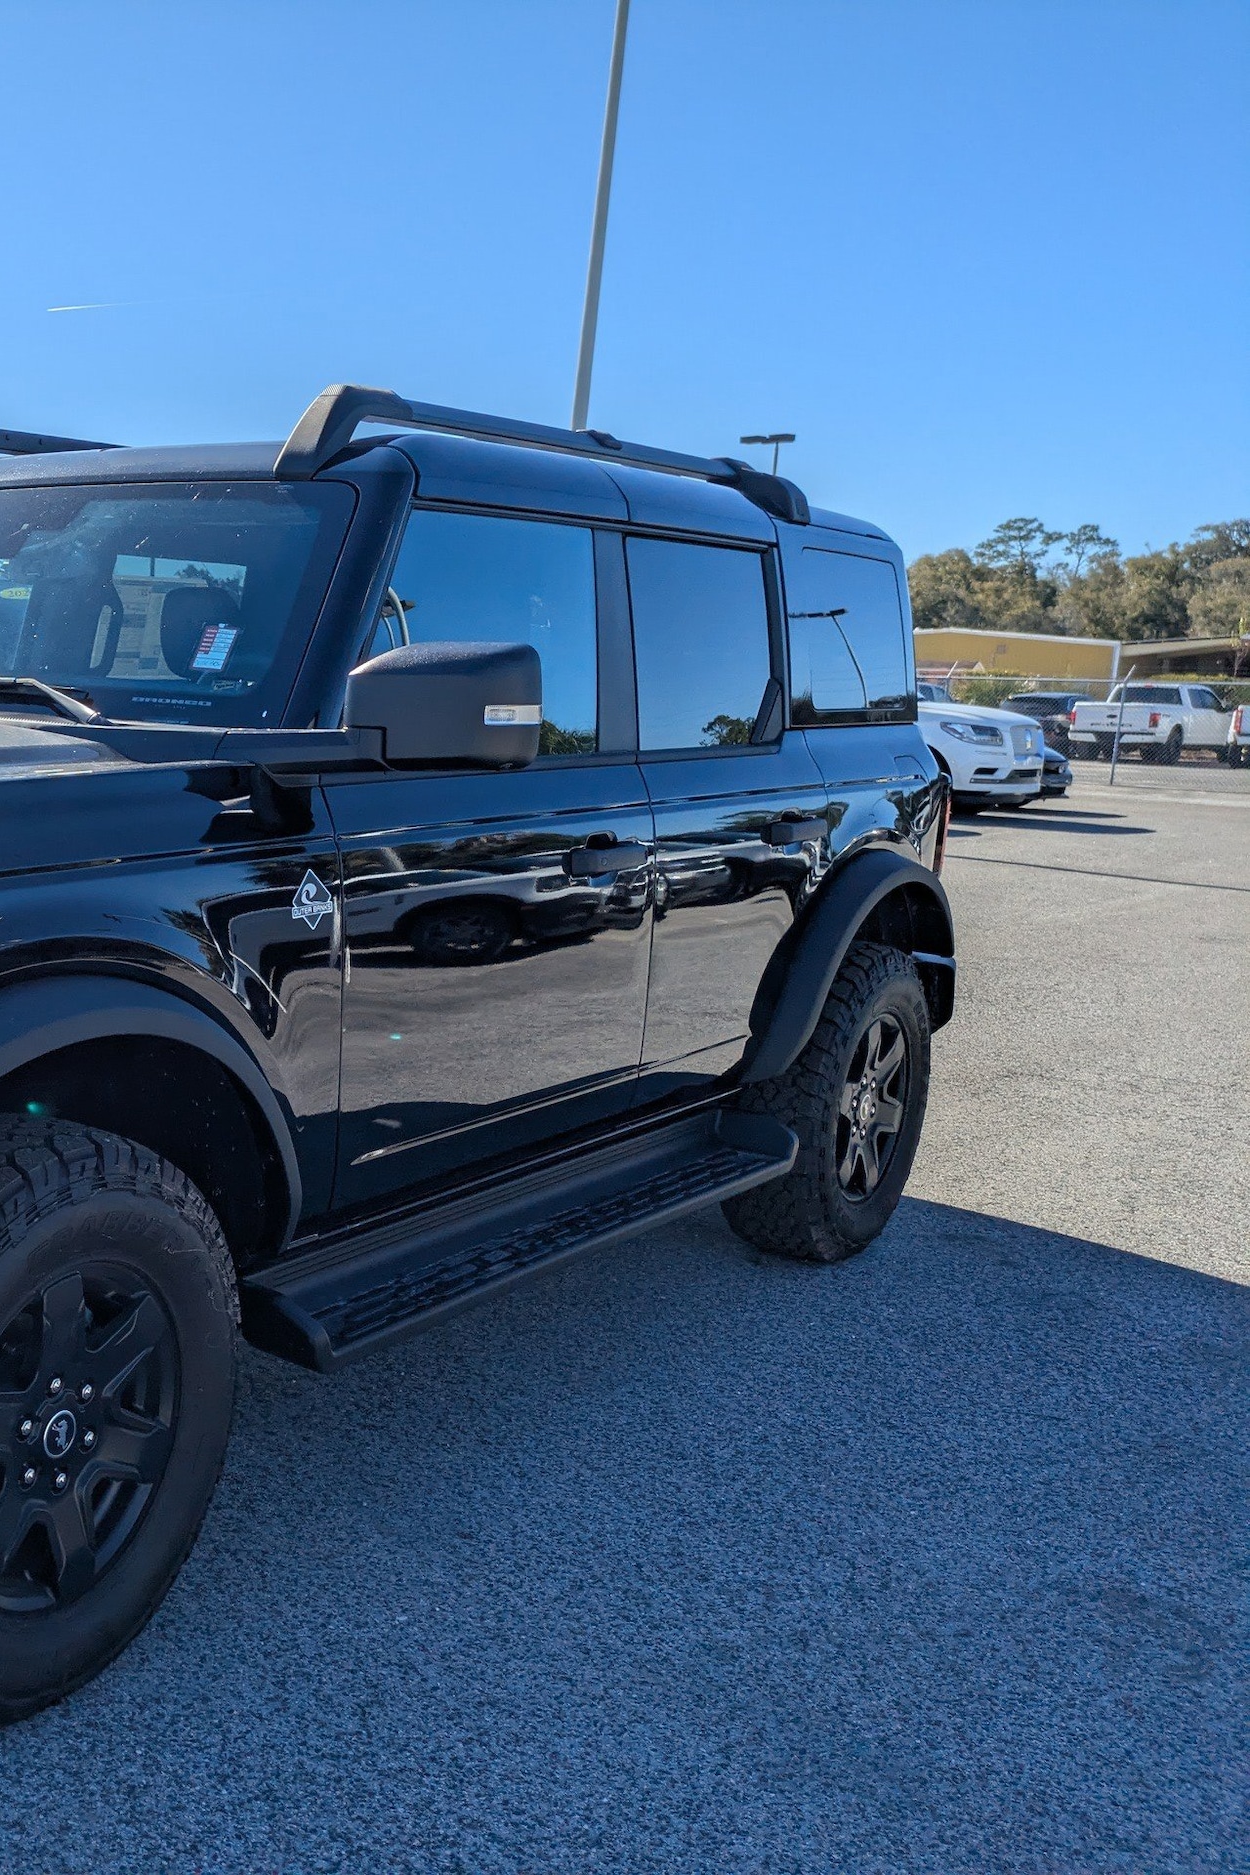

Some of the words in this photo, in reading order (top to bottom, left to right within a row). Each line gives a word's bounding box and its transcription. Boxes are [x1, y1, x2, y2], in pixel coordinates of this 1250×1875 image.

[132, 696, 212, 707] BRONCO
[294, 906, 313, 916] OUTER
[313, 902, 331, 912] BANKS
